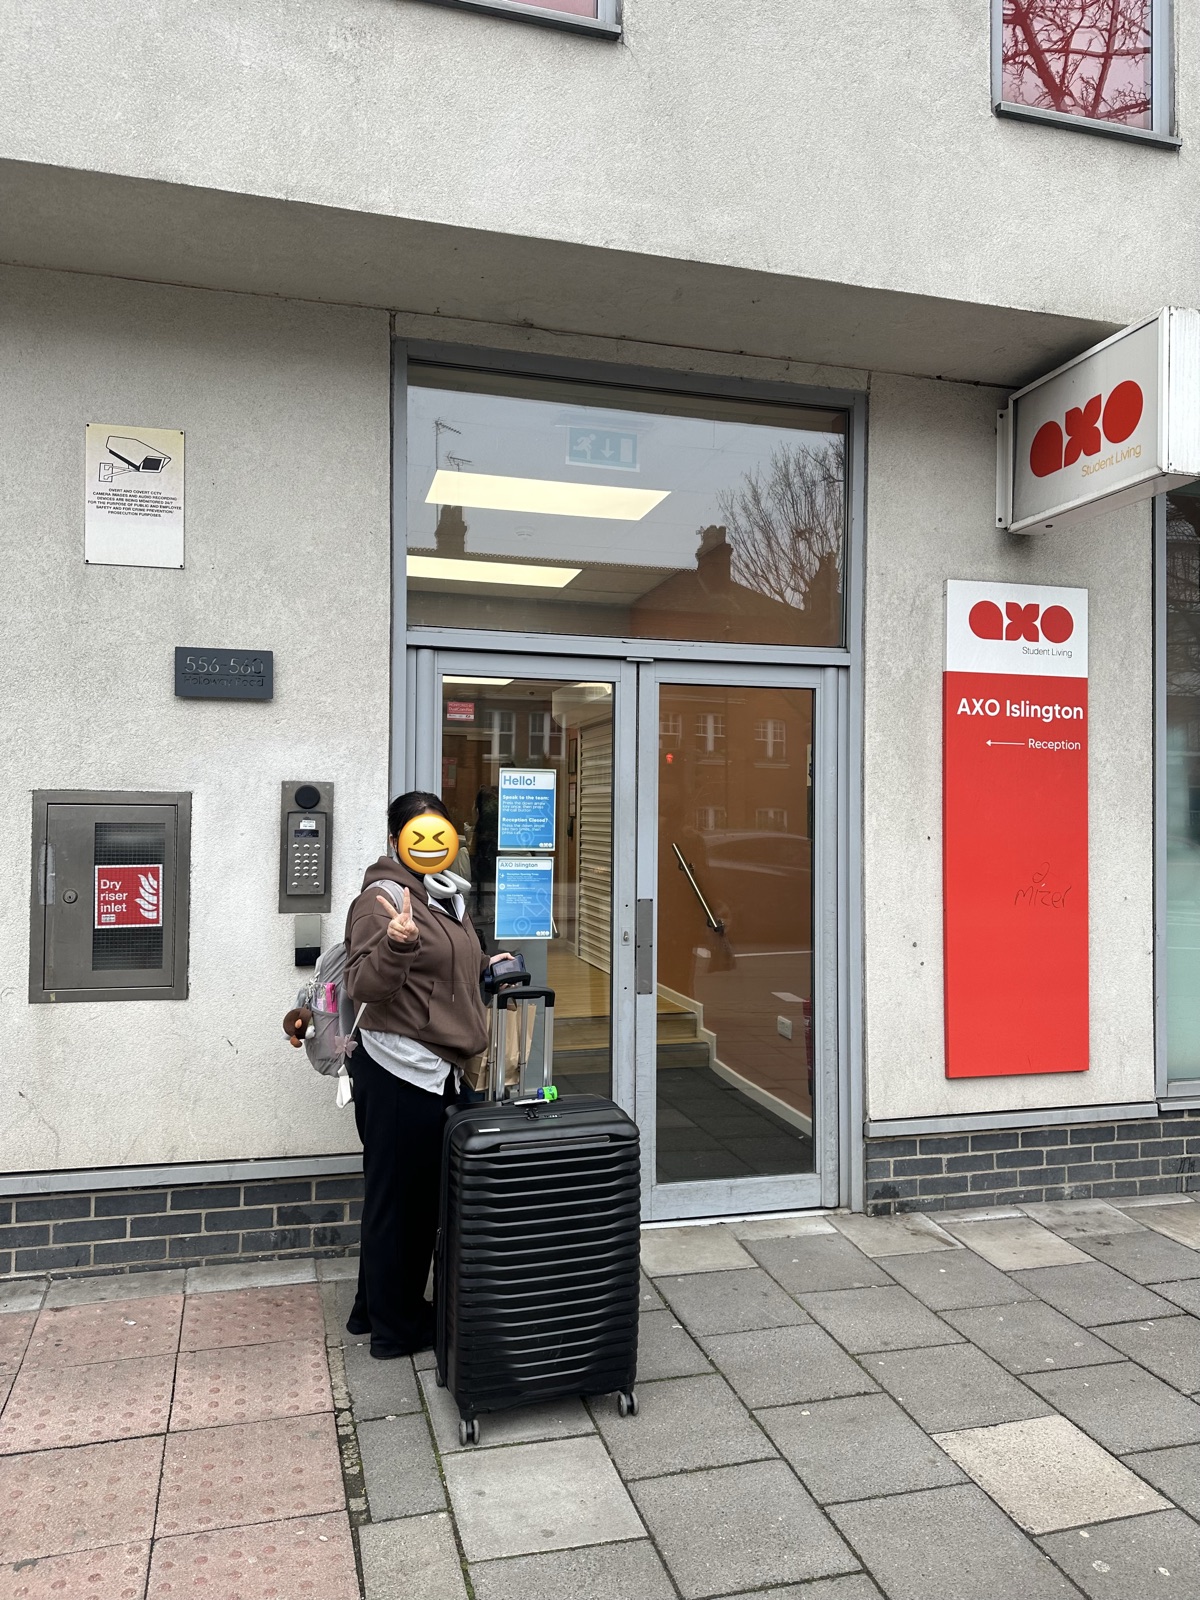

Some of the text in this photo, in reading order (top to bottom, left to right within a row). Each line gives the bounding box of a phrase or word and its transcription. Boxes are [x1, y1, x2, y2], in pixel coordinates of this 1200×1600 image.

[1081, 444, 1142, 478] Student Living
[1022, 646, 1072, 658] Student Living
[185, 656, 264, 674] 556-560
[957, 698, 1083, 722] AXO Islington
[1028, 738, 1080, 751] Reception
[504, 775, 535, 786] Hello!
[101, 879, 121, 890] Dry
[101, 891, 128, 900] riser
[101, 903, 126, 912] inlet
